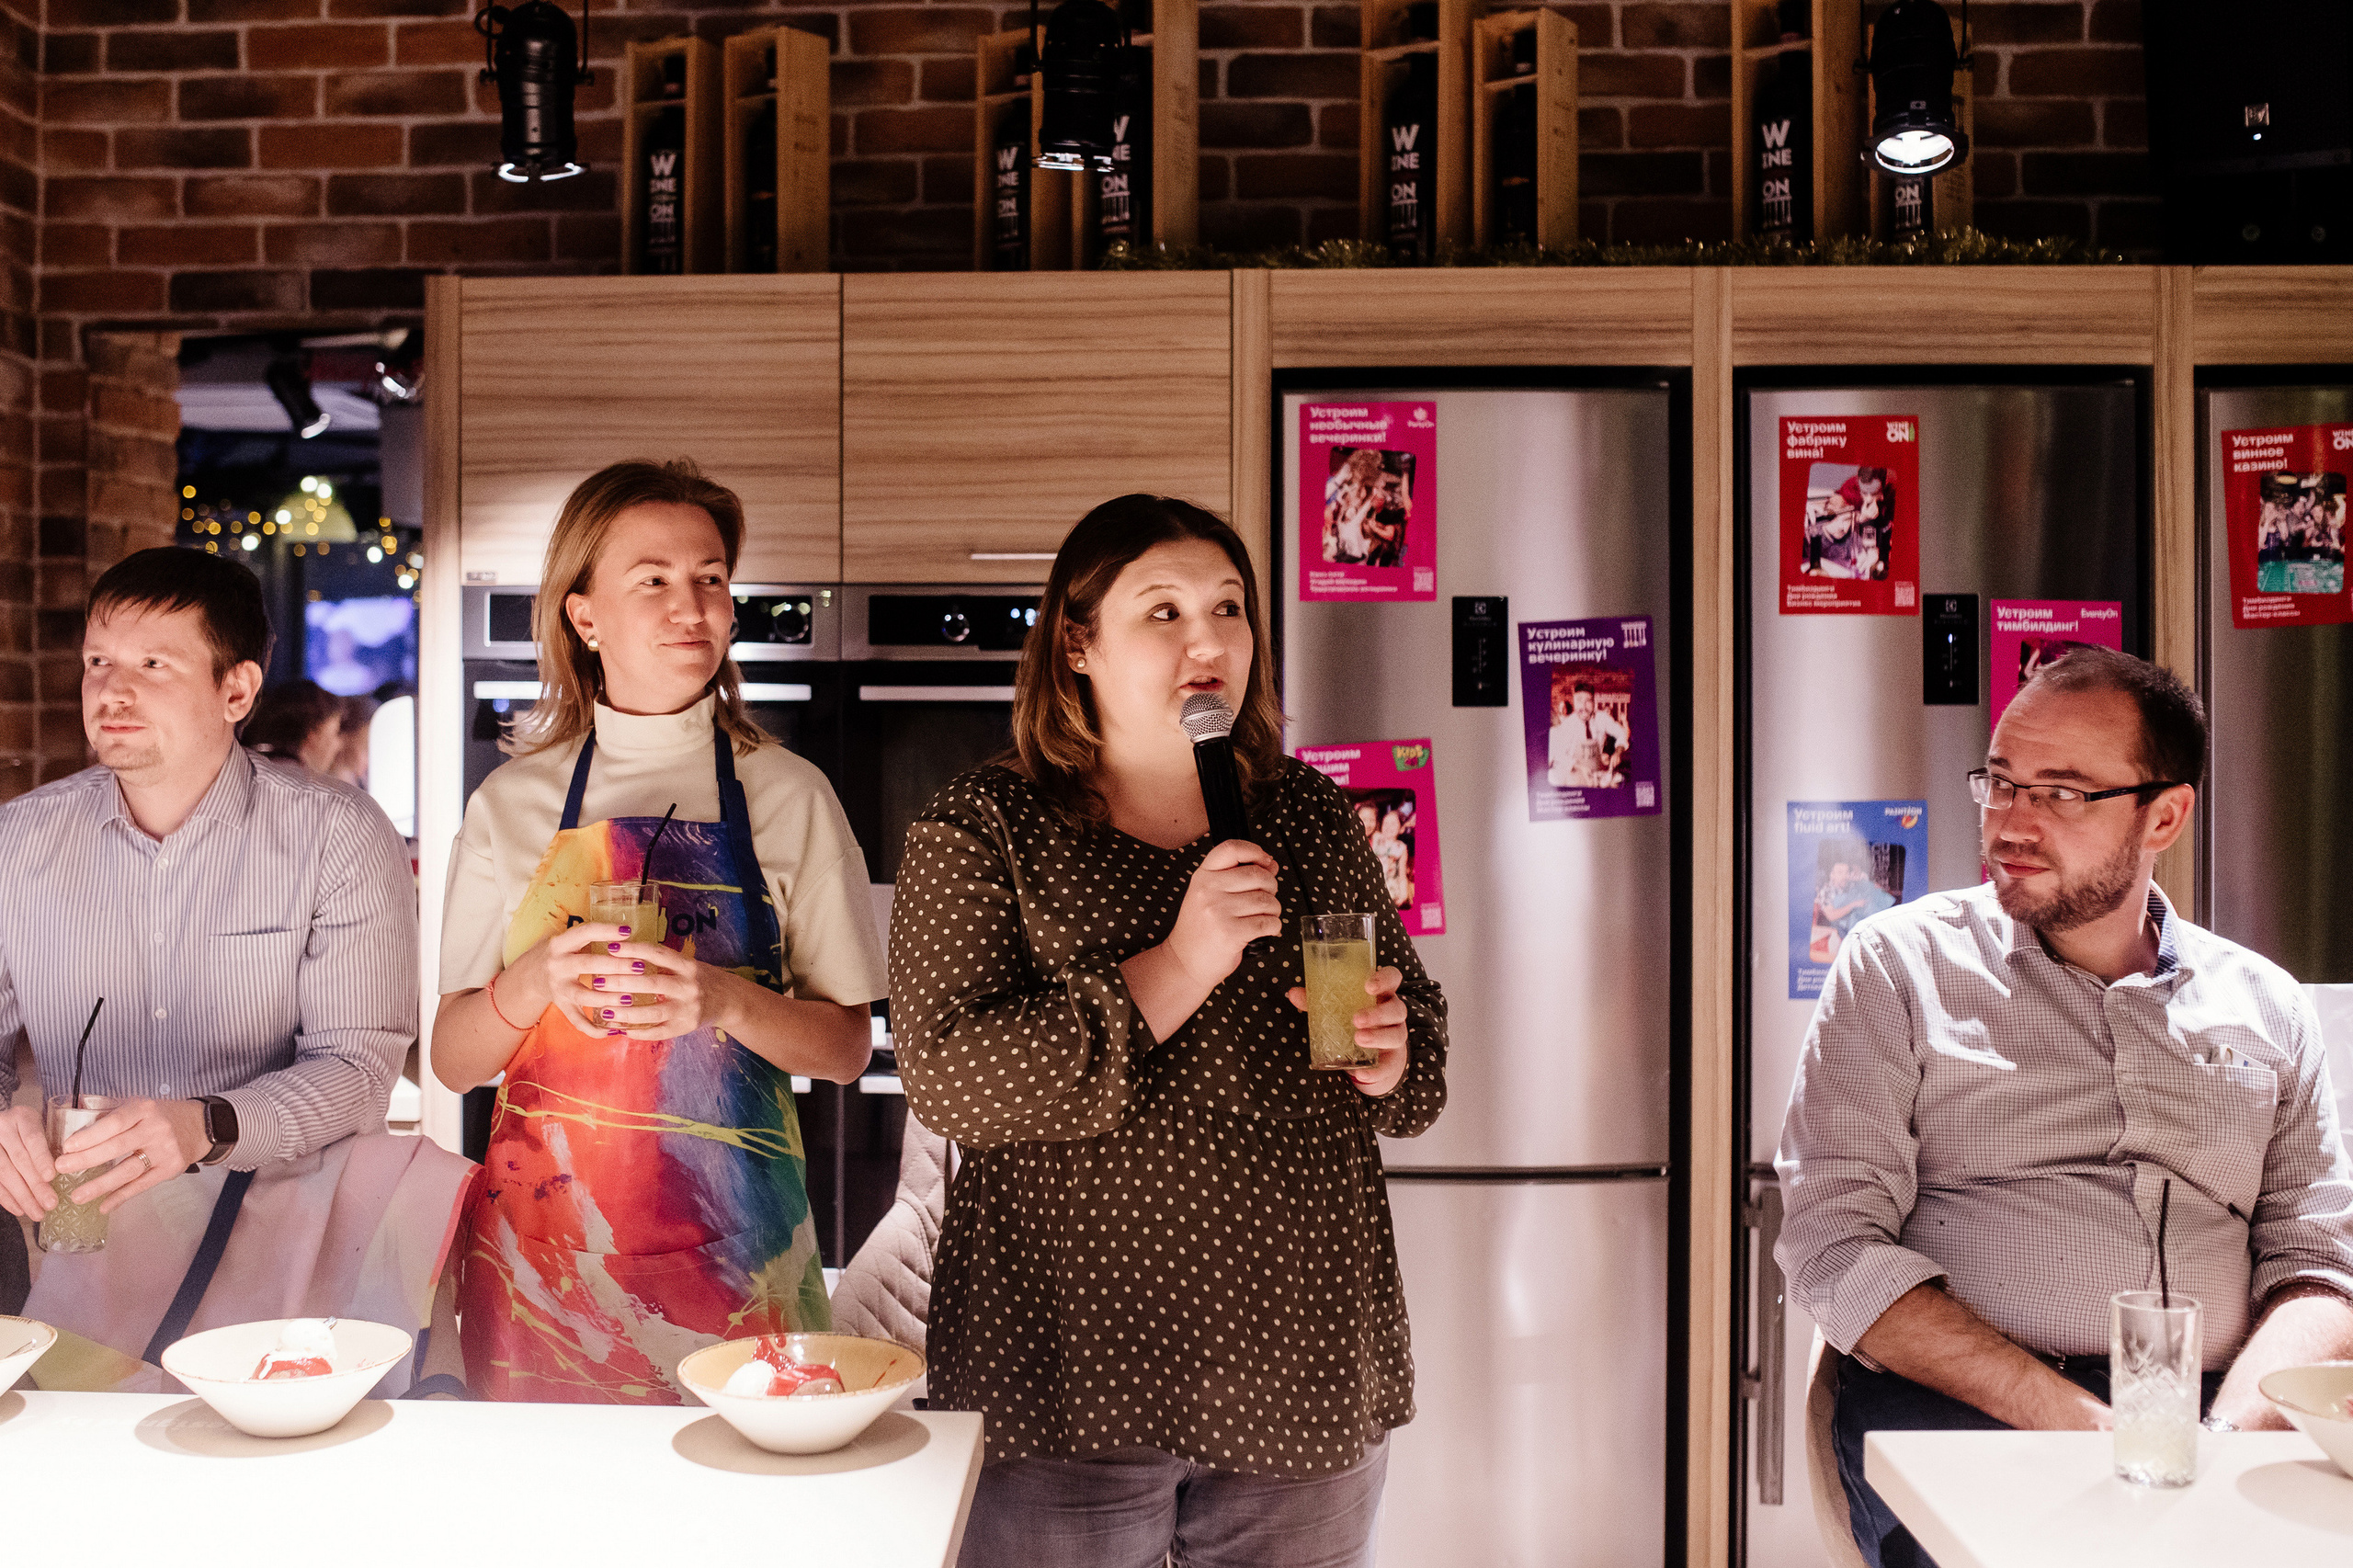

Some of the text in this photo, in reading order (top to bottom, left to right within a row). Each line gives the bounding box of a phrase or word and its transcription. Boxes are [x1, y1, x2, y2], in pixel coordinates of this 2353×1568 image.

[1392, 124, 1420, 151] W
[1760, 119, 1790, 148] W
[651, 153, 677, 176] W
[1392, 181, 1416, 201] ON
[1763, 177, 1790, 199] ON
[1894, 185, 1920, 202] ON
[1310, 406, 1369, 420] Устроим
[1787, 421, 1847, 437] Устроим
[1887, 429, 1909, 442] ON
[1309, 431, 1386, 445] вечеринки!
[1787, 434, 1847, 449] фабрику
[2232, 433, 2294, 448] Устроим
[1787, 446, 1824, 459] вина!
[2233, 447, 2284, 460] винное
[2234, 457, 2288, 472] казино!
[1997, 606, 2053, 621] Устроим
[1997, 619, 2078, 633] тимбилдинг!
[1527, 627, 1586, 641] Устроим
[1528, 637, 1615, 653] кулинарную
[1528, 648, 1607, 665] вечеринку!
[1302, 749, 1361, 763] Устроим
[1794, 808, 1854, 821] Устроим
